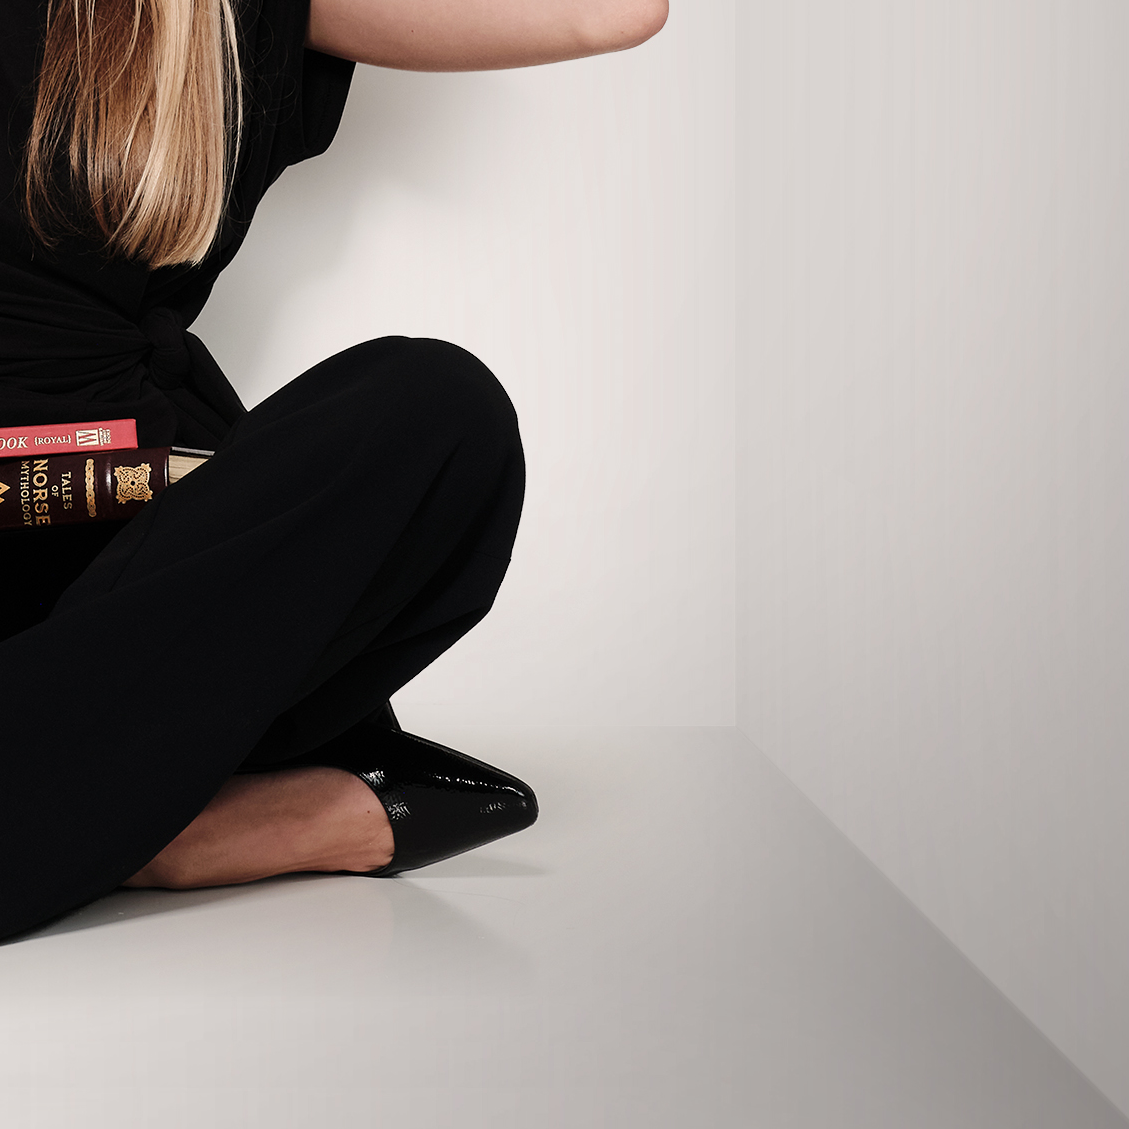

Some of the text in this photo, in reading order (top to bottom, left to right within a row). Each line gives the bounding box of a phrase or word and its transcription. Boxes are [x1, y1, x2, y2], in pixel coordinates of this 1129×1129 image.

[20, 460, 33, 526] MYTHOLOGY
[33, 459, 51, 526] NORSE
[51, 485, 59, 497] OF
[61, 472, 72, 510] TALES
